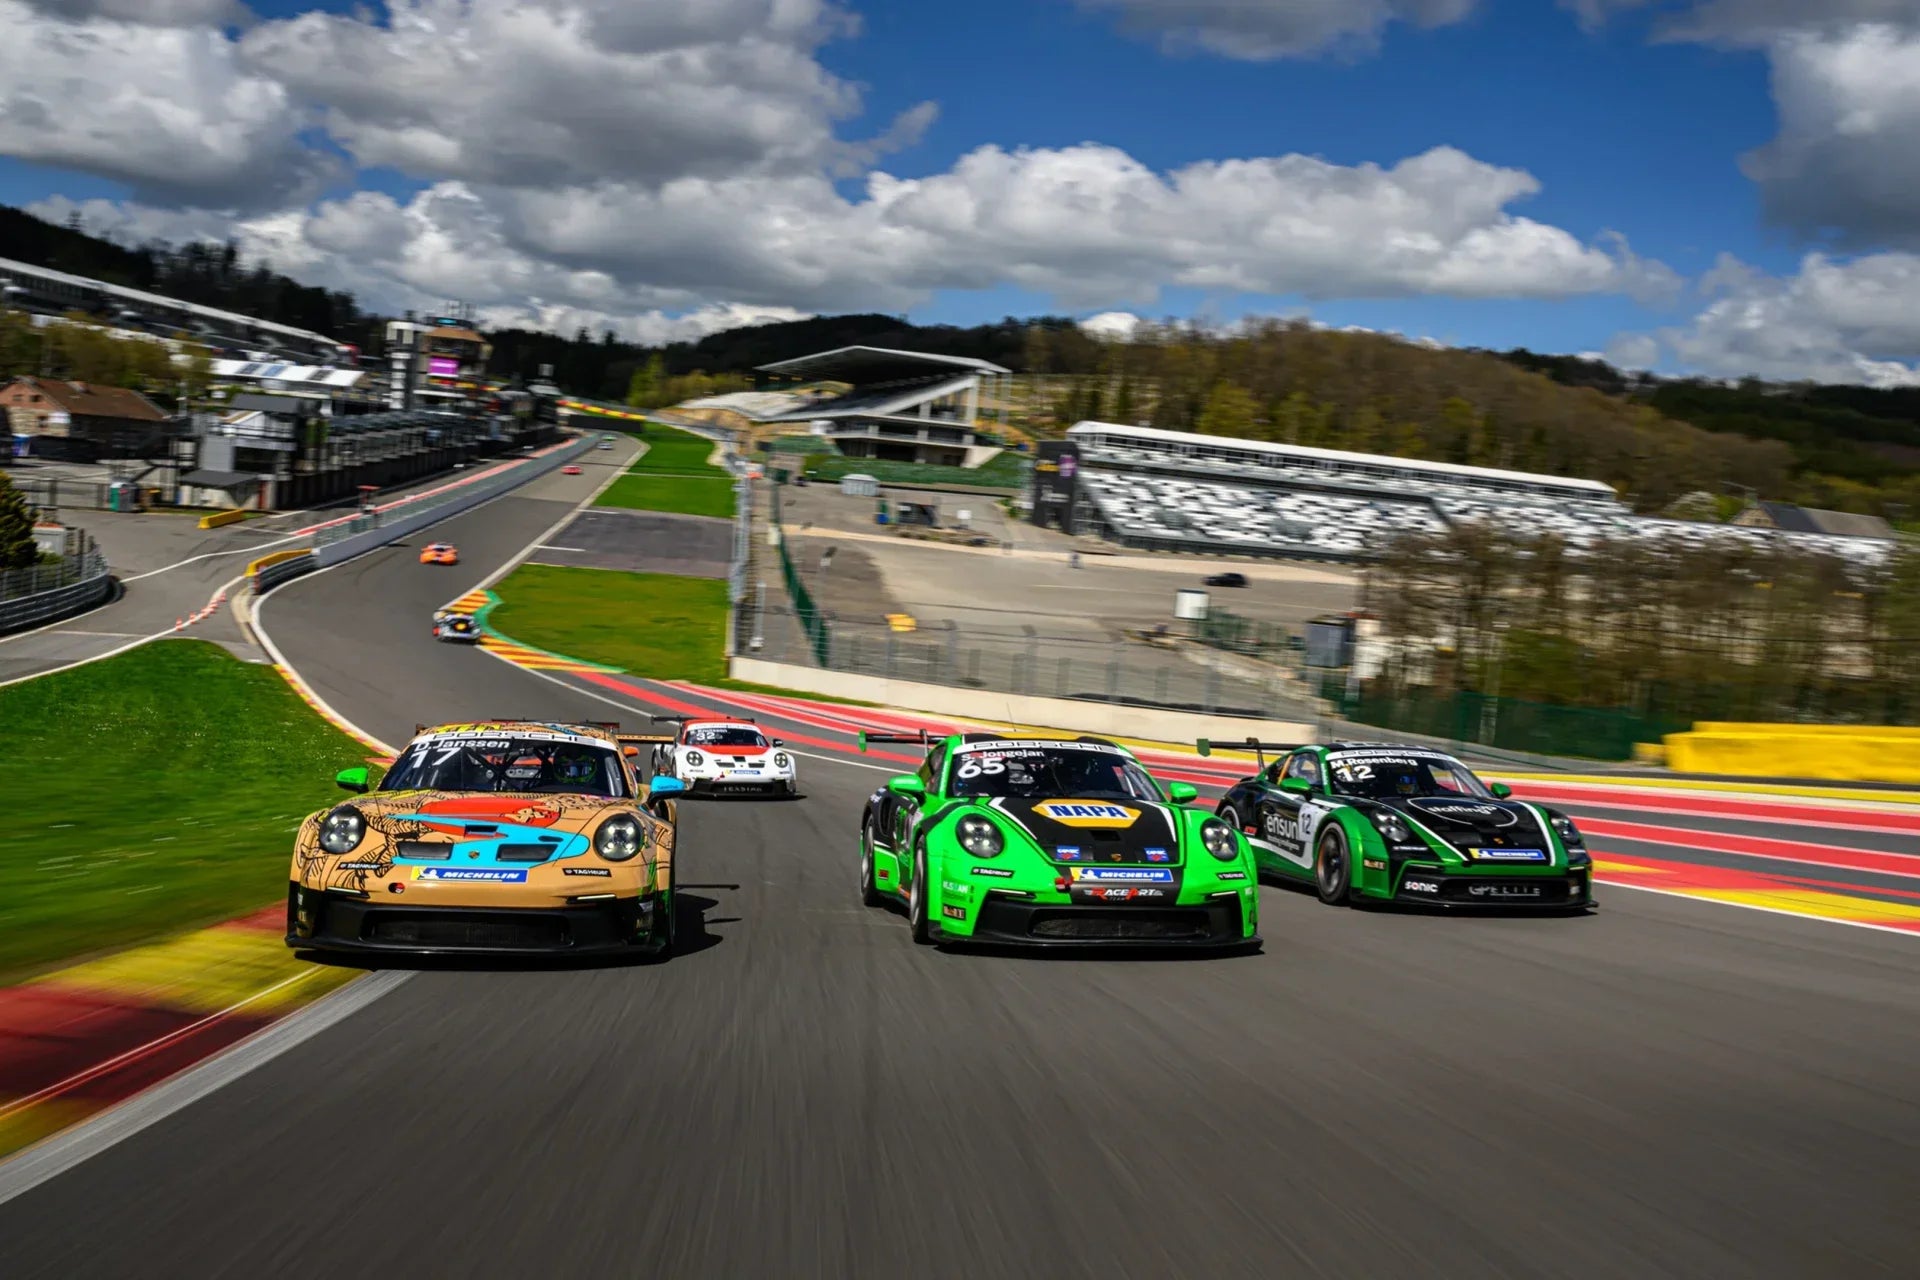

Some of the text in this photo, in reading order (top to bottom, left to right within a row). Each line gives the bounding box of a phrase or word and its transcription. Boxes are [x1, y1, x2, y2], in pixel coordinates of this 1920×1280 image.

[414, 739, 510, 752] D.Janssen
[409, 747, 461, 769] 17
[981, 750, 1045, 759] Jongejan
[958, 757, 1006, 779] 65
[1336, 765, 1377, 782] 12
[1048, 805, 1128, 818] NAPA
[1266, 815, 1299, 840] ensun
[1301, 812, 1312, 835] 12
[443, 871, 519, 879] MICHELIN
